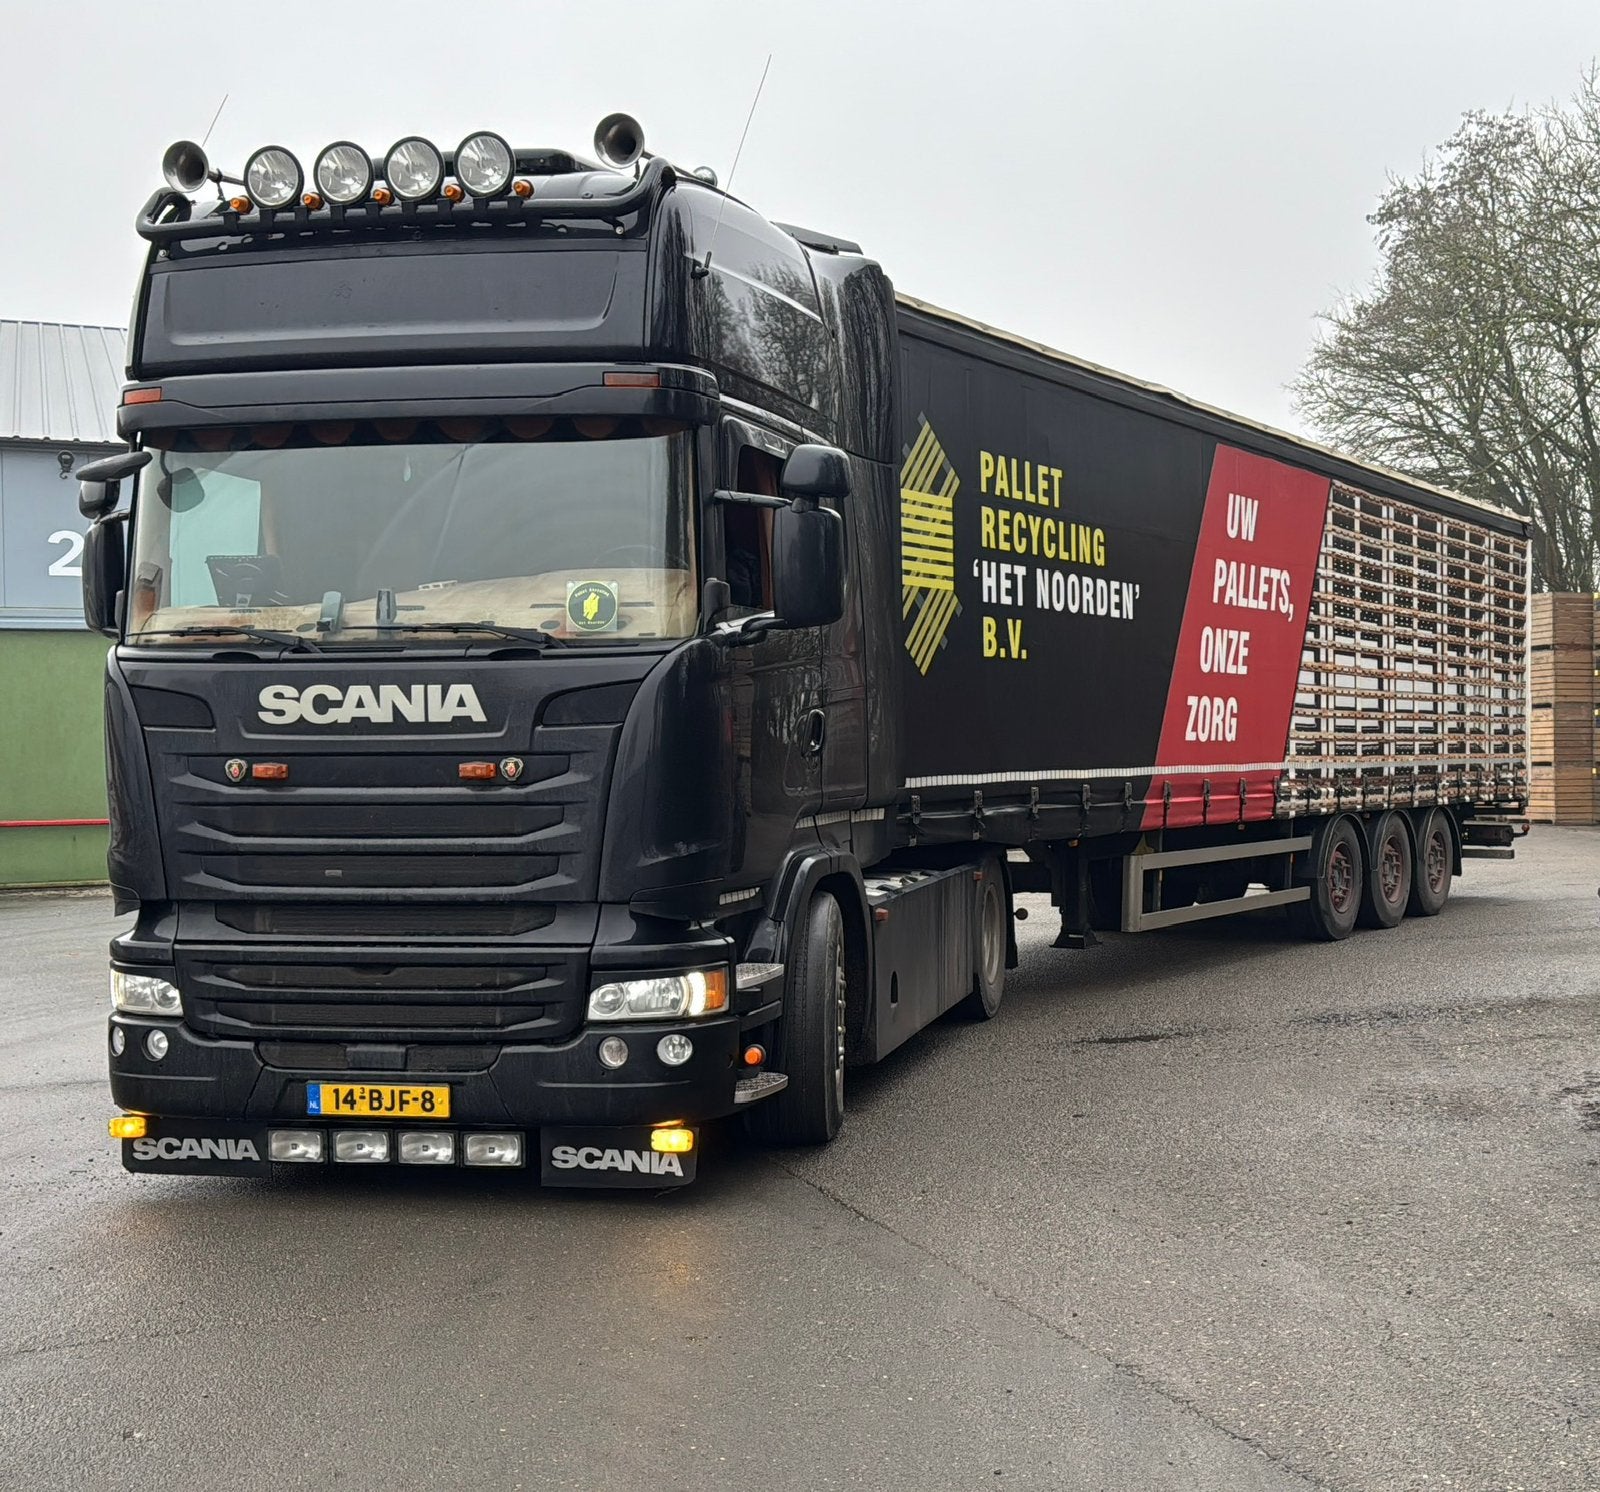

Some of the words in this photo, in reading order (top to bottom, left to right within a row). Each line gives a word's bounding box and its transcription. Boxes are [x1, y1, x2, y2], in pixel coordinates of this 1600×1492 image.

[980, 450, 1062, 508] PALLET
[981, 505, 1105, 567] RECYCLING
[1226, 493, 1259, 542] UW
[47, 530, 85, 577] 2
[973, 558, 1027, 607] ‘HET
[1036, 567, 1140, 620] NOORDEN’
[1212, 558, 1294, 622] PALLETS,
[982, 616, 1027, 659] B.V.
[1200, 626, 1250, 675] ONZE
[257, 684, 488, 725] SCANIA
[1185, 695, 1238, 742] ZORG
[309, 1101, 319, 1109] NL
[132, 1137, 261, 1161] SCANIA
[551, 1146, 684, 1177] SCANIA
